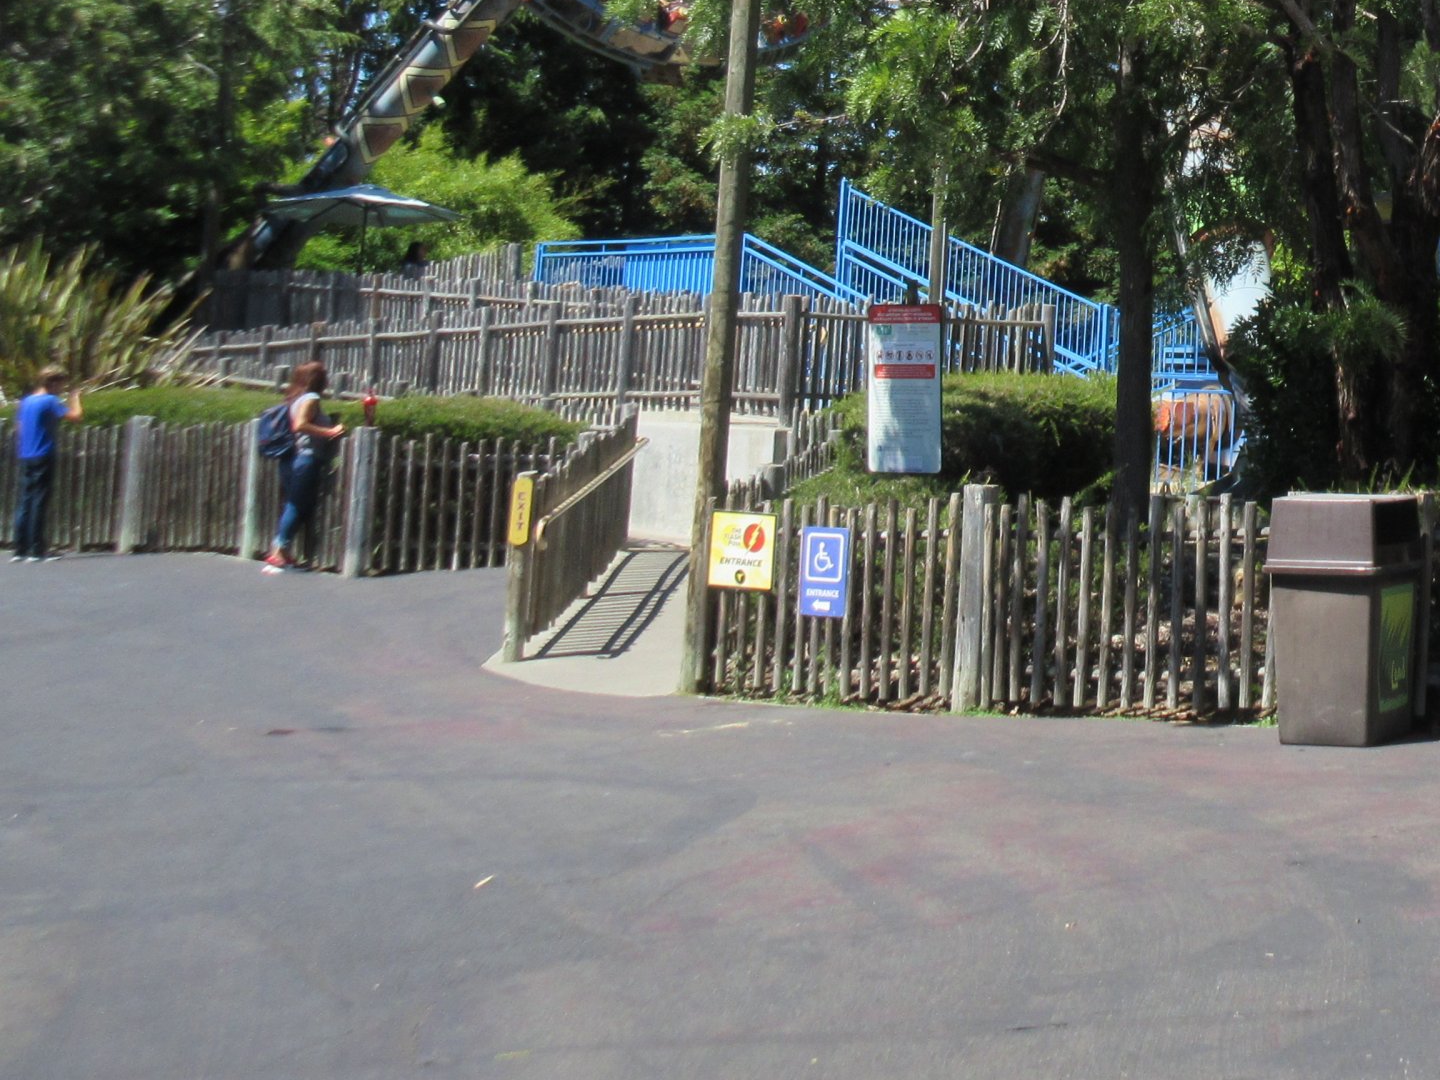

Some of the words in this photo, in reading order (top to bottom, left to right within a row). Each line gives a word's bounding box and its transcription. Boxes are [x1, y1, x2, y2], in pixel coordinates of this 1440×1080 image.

[516, 492, 526, 530] EXIT
[719, 556, 763, 568] ENTRANCE
[806, 588, 840, 599] ENTRANCE
